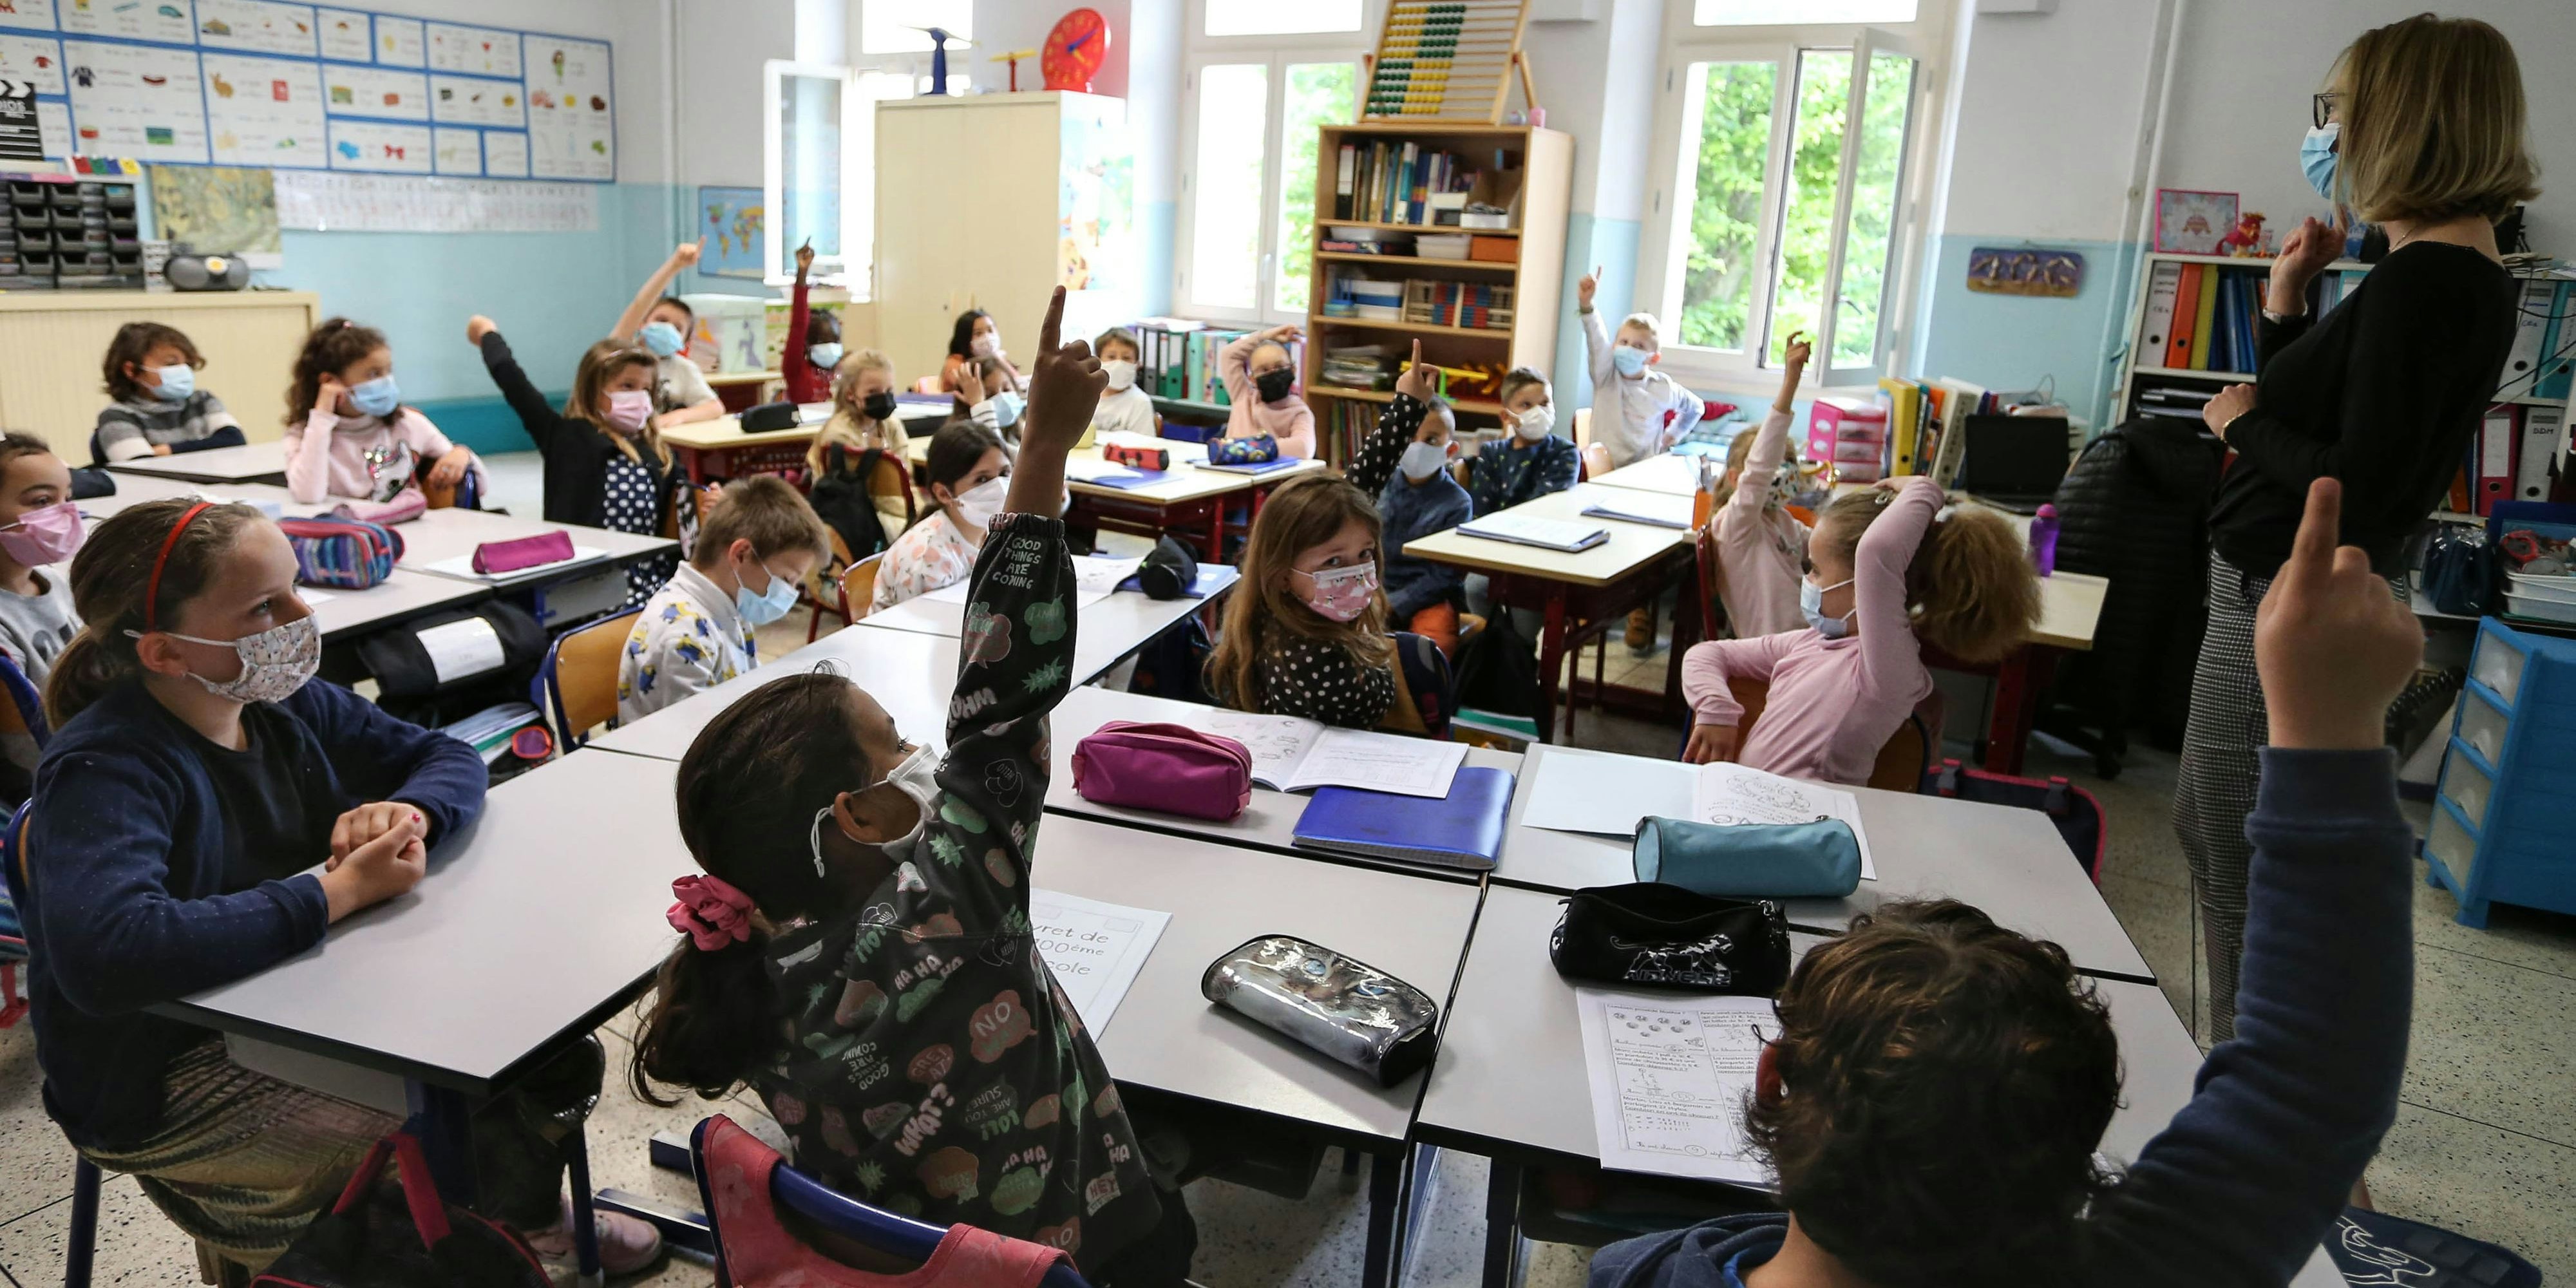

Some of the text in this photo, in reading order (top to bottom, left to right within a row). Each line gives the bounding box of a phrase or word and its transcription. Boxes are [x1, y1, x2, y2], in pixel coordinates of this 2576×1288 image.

[1012, 537, 1041, 551] GOOD
[1005, 547, 1041, 564] THINGS
[1006, 563, 1030, 574] ARE
[992, 571, 1034, 589] COMING
[1032, 925, 1109, 943] vret de
[894, 969, 914, 990] HA
[913, 954, 943, 978] HA
[1046, 960, 1091, 975] cole
[975, 1001, 1011, 1037] NO
[858, 1063, 890, 1091] GOOD
[894, 1082, 956, 1157] WHAT?
[980, 1108, 1021, 1141] LOL!
[1023, 1144, 1048, 1164] HA
[1108, 1144, 1131, 1163] HA
